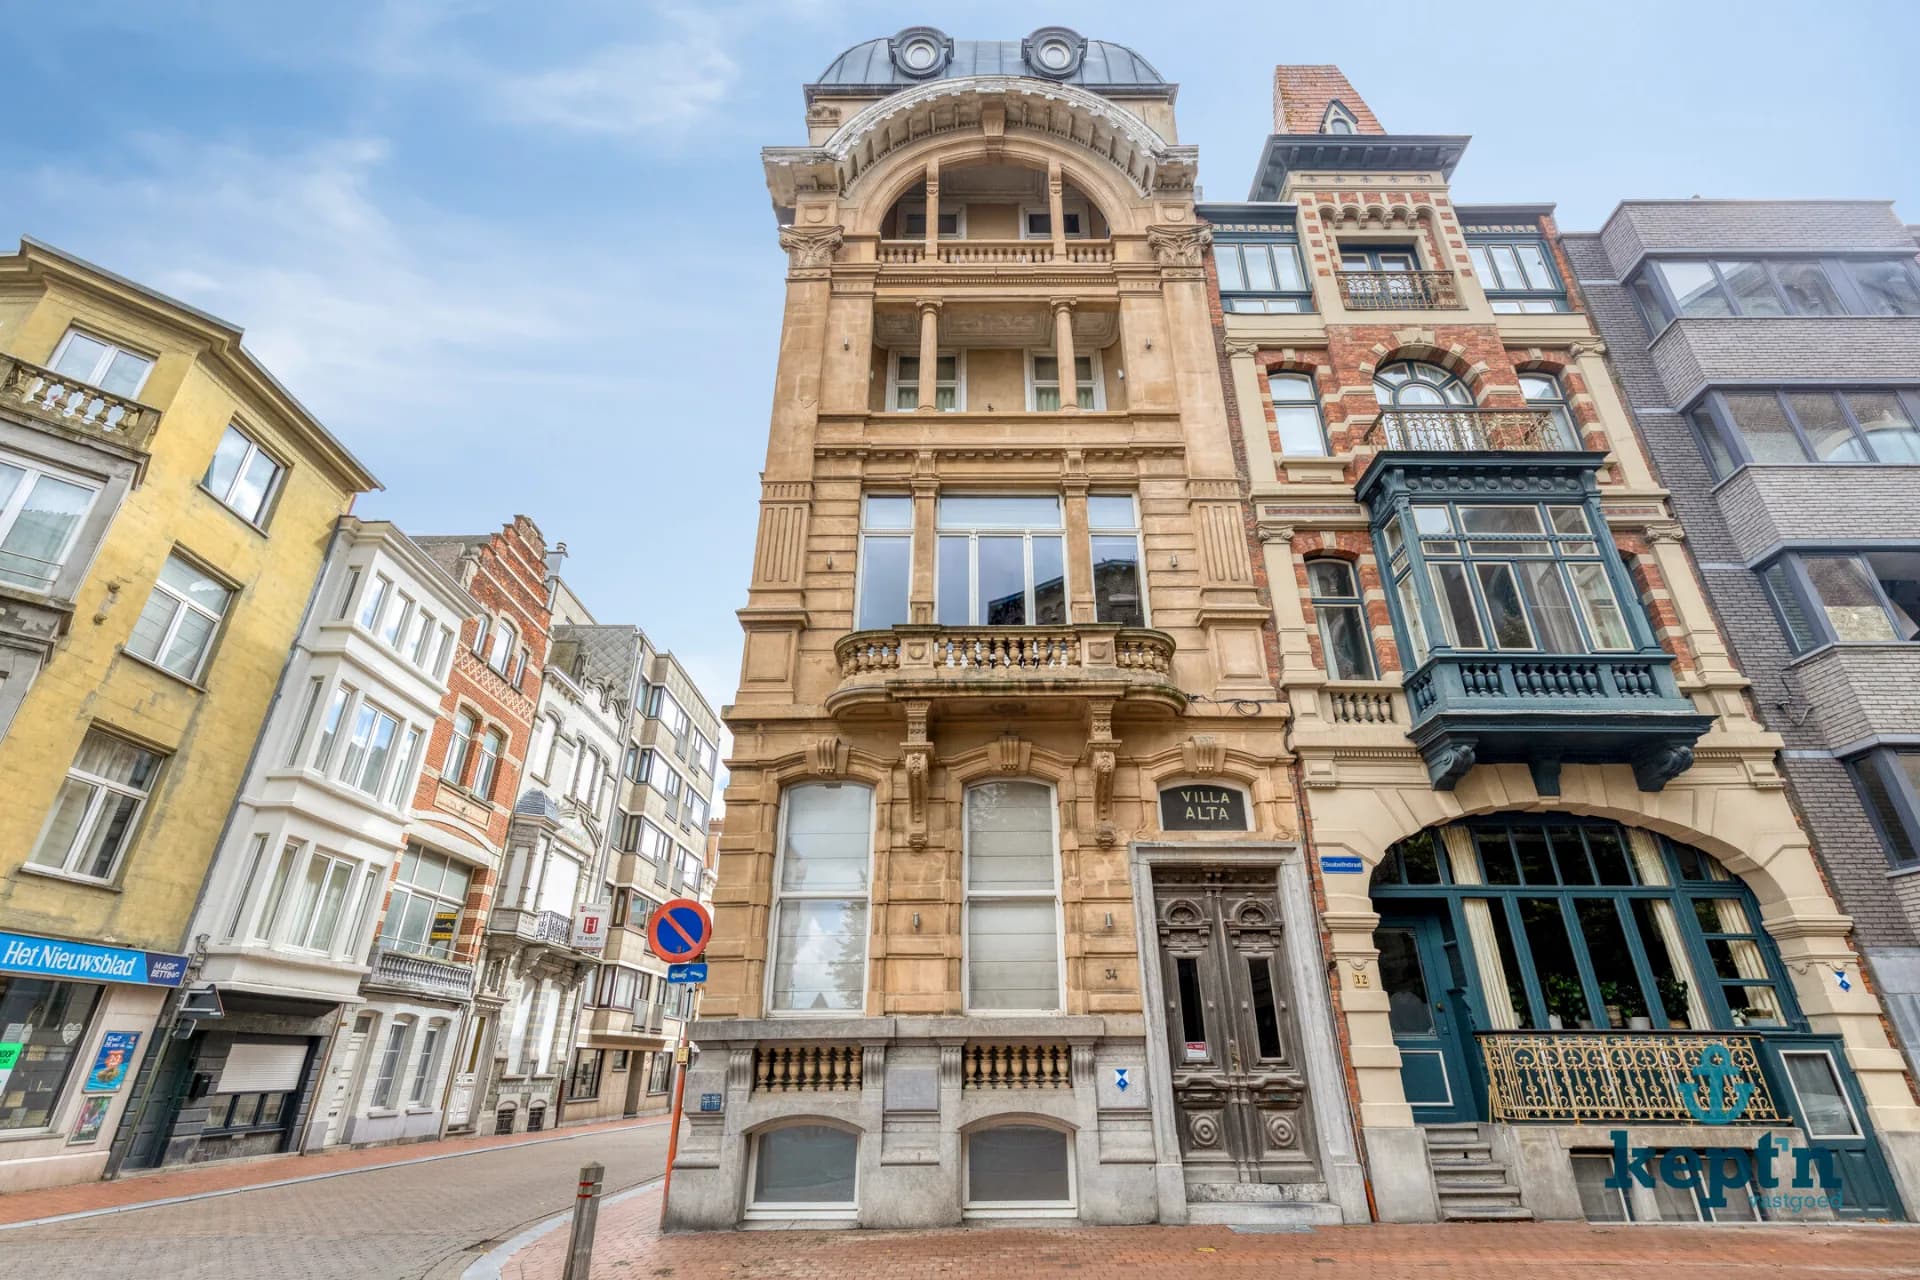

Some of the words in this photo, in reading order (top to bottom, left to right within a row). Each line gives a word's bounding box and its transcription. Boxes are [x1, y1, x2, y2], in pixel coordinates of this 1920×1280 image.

[1181, 791, 1231, 804] VILLA
[1185, 806, 1230, 821] ALTA
[2, 940, 40, 967] Het
[37, 945, 137, 977] Nieuwsblad
[1105, 969, 1118, 981] 34
[1354, 974, 1368, 985] 32
